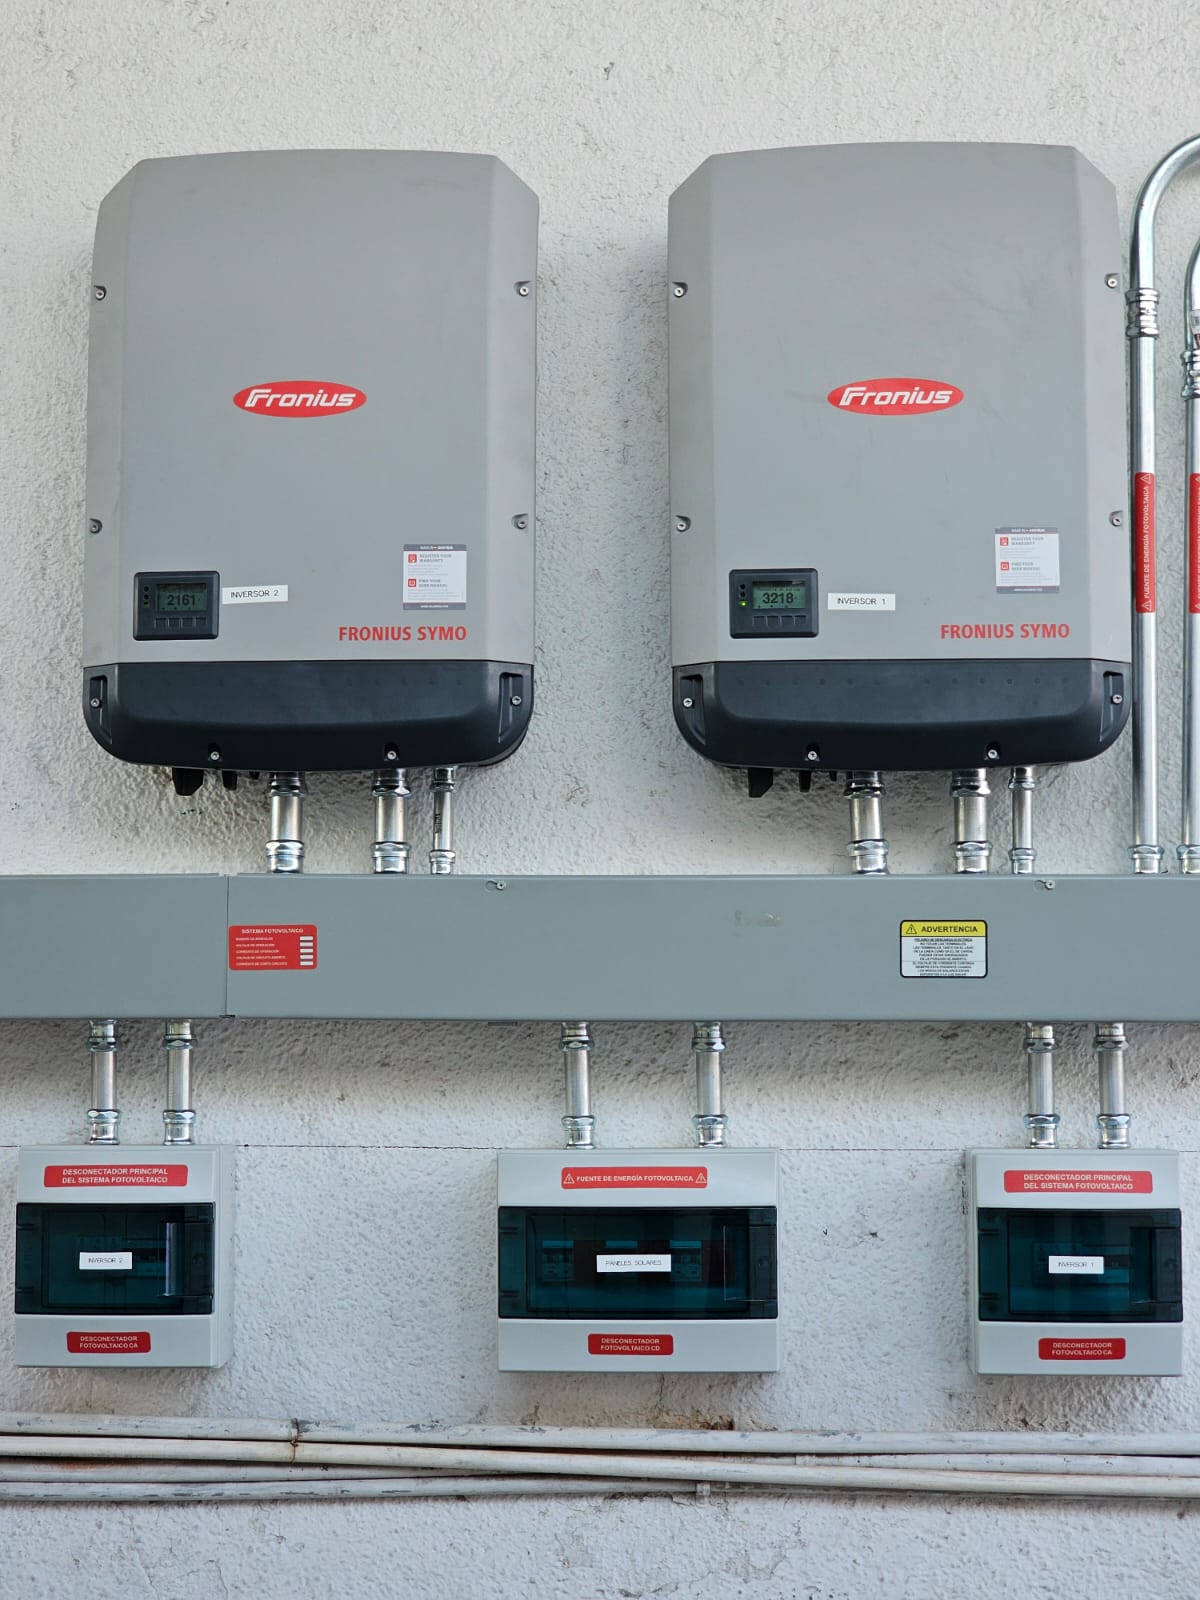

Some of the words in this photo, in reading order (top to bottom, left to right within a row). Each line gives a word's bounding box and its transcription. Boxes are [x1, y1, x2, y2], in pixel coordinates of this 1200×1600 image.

[244, 388, 357, 408] Fronius
[839, 386, 954, 406] Fronius
[1143, 563, 1150, 572] DE
[167, 594, 196, 606] 2161
[230, 590, 270, 599] INVERSOR
[762, 592, 794, 604] 3218
[338, 626, 412, 640] FRONIUS
[417, 626, 467, 640] SYMO
[940, 624, 1014, 639] FRONIUS
[1020, 624, 1070, 639] SYMO
